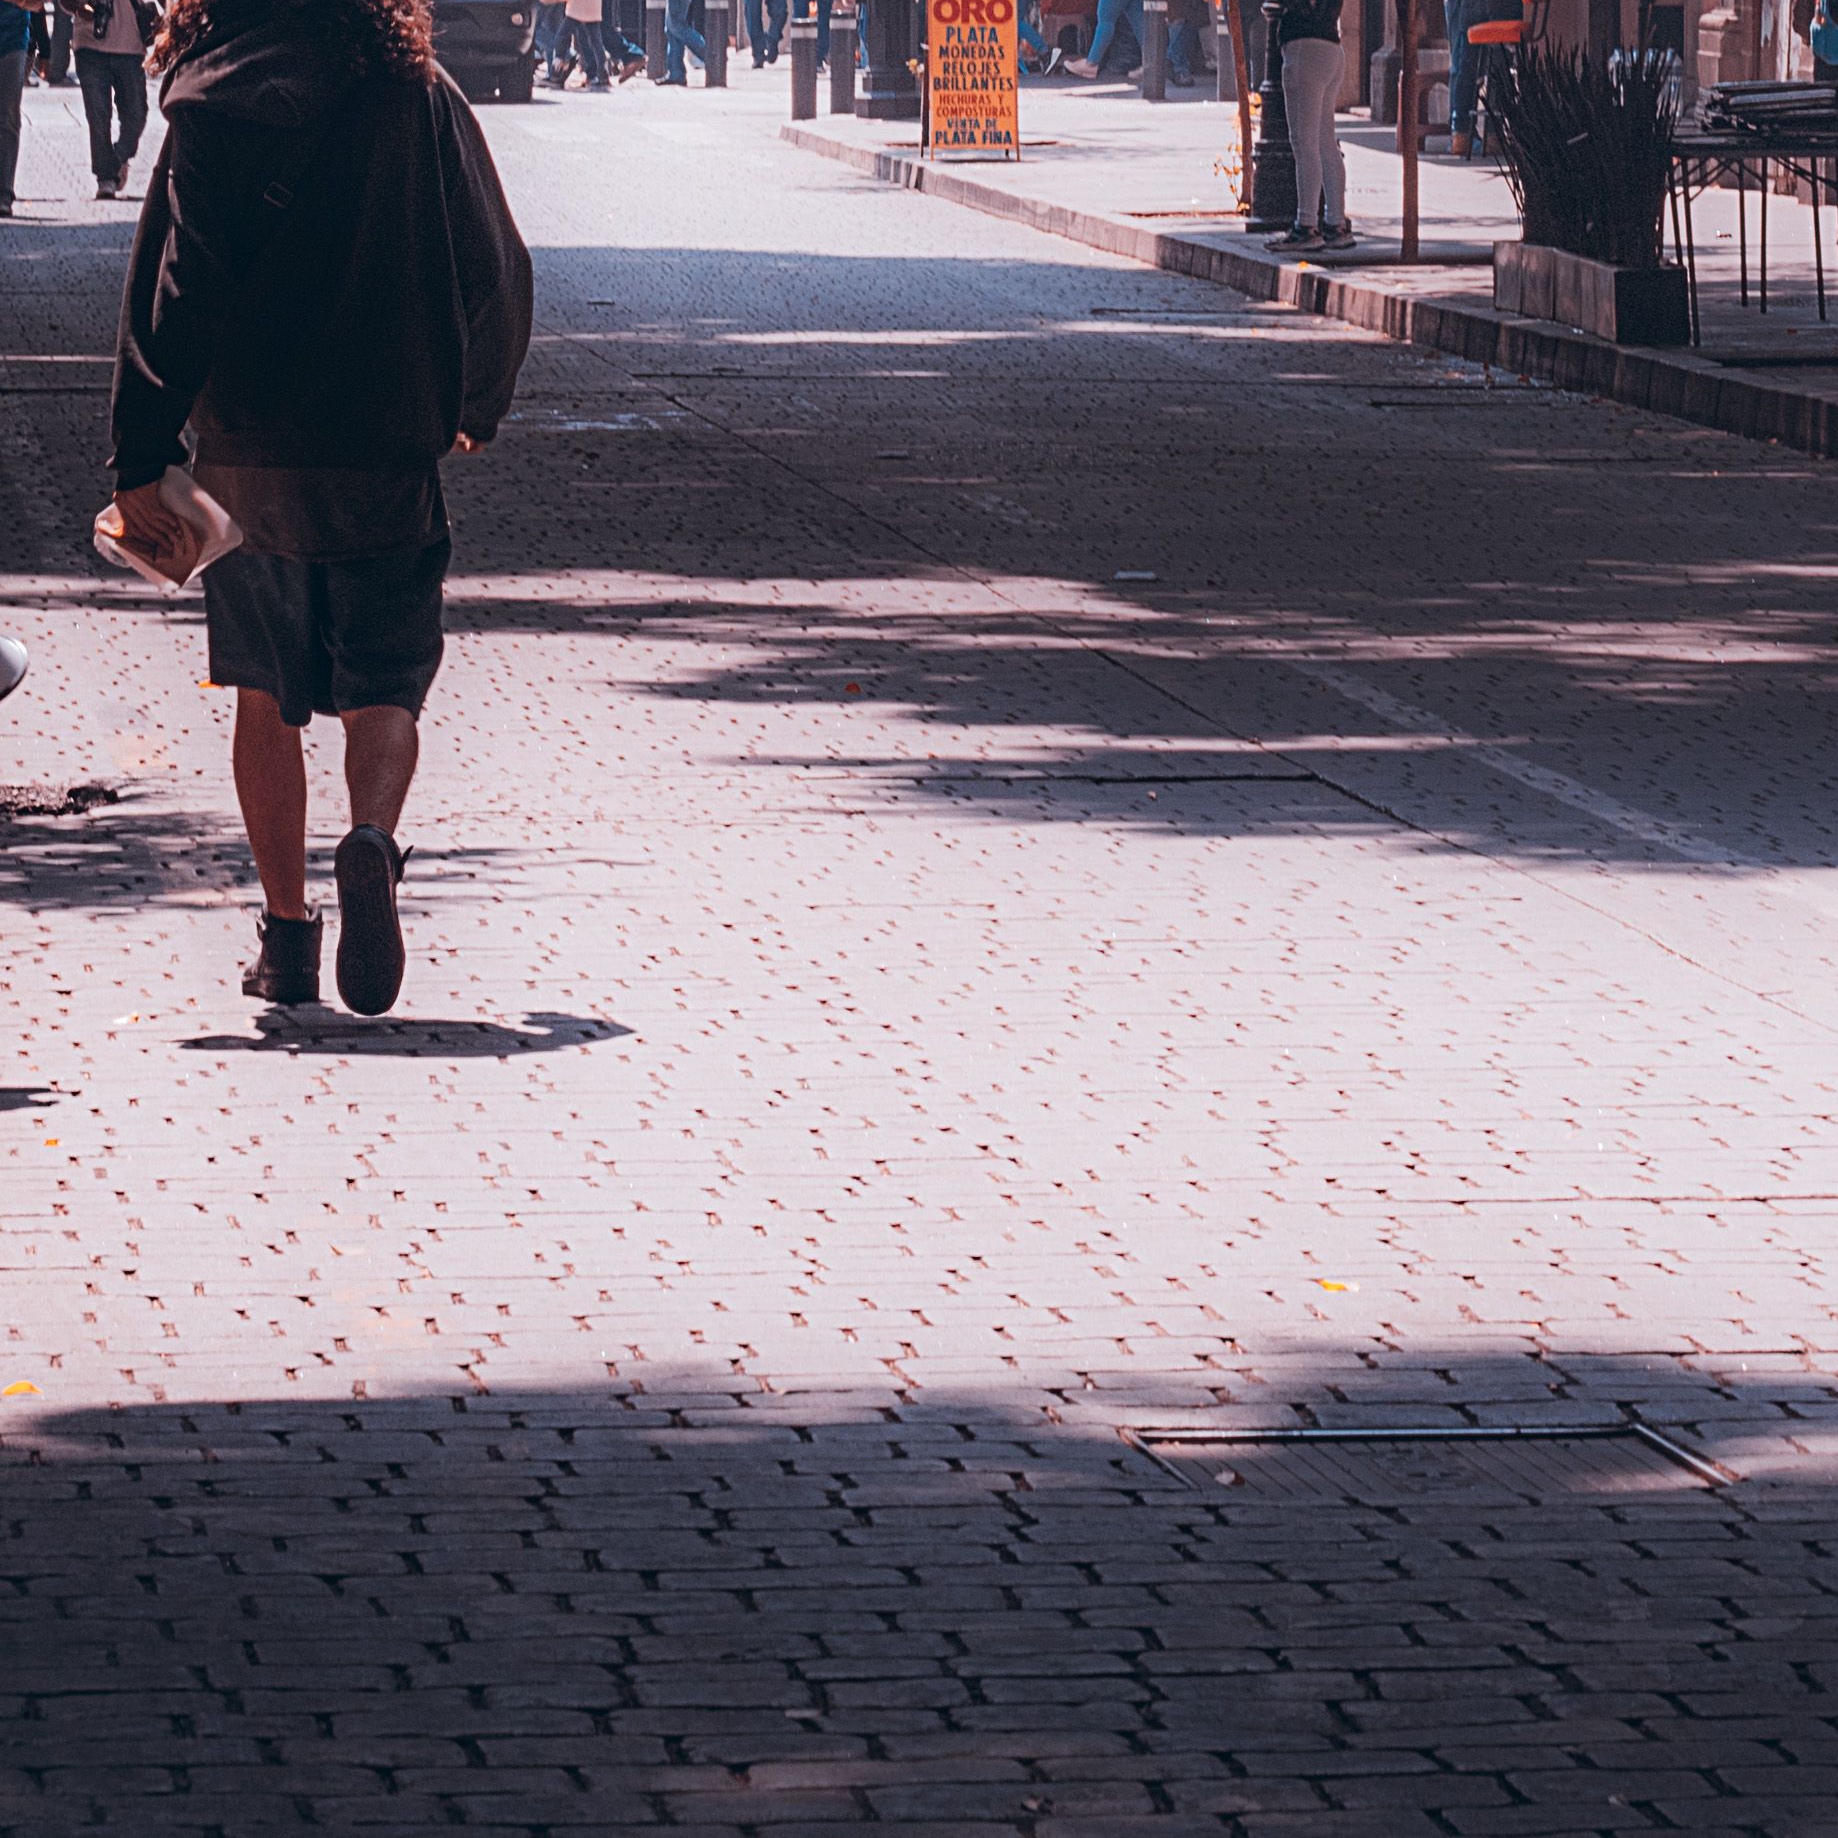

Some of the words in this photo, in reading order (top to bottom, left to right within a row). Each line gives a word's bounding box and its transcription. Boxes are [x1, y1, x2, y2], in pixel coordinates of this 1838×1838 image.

[946, 26, 999, 44] PLATA
[939, 45, 1005, 59] MONEDAS
[943, 62, 1000, 75] RELOJES
[933, 77, 1014, 92] BRILLANTES
[939, 94, 992, 105] HECHURAS
[997, 94, 1005, 105] Y
[936, 106, 1012, 117] COMPOSTURAS
[947, 118, 980, 130] VENTA
[985, 118, 997, 130] DE
[935, 131, 977, 145] PLATA
[982, 131, 1012, 145] FINA
